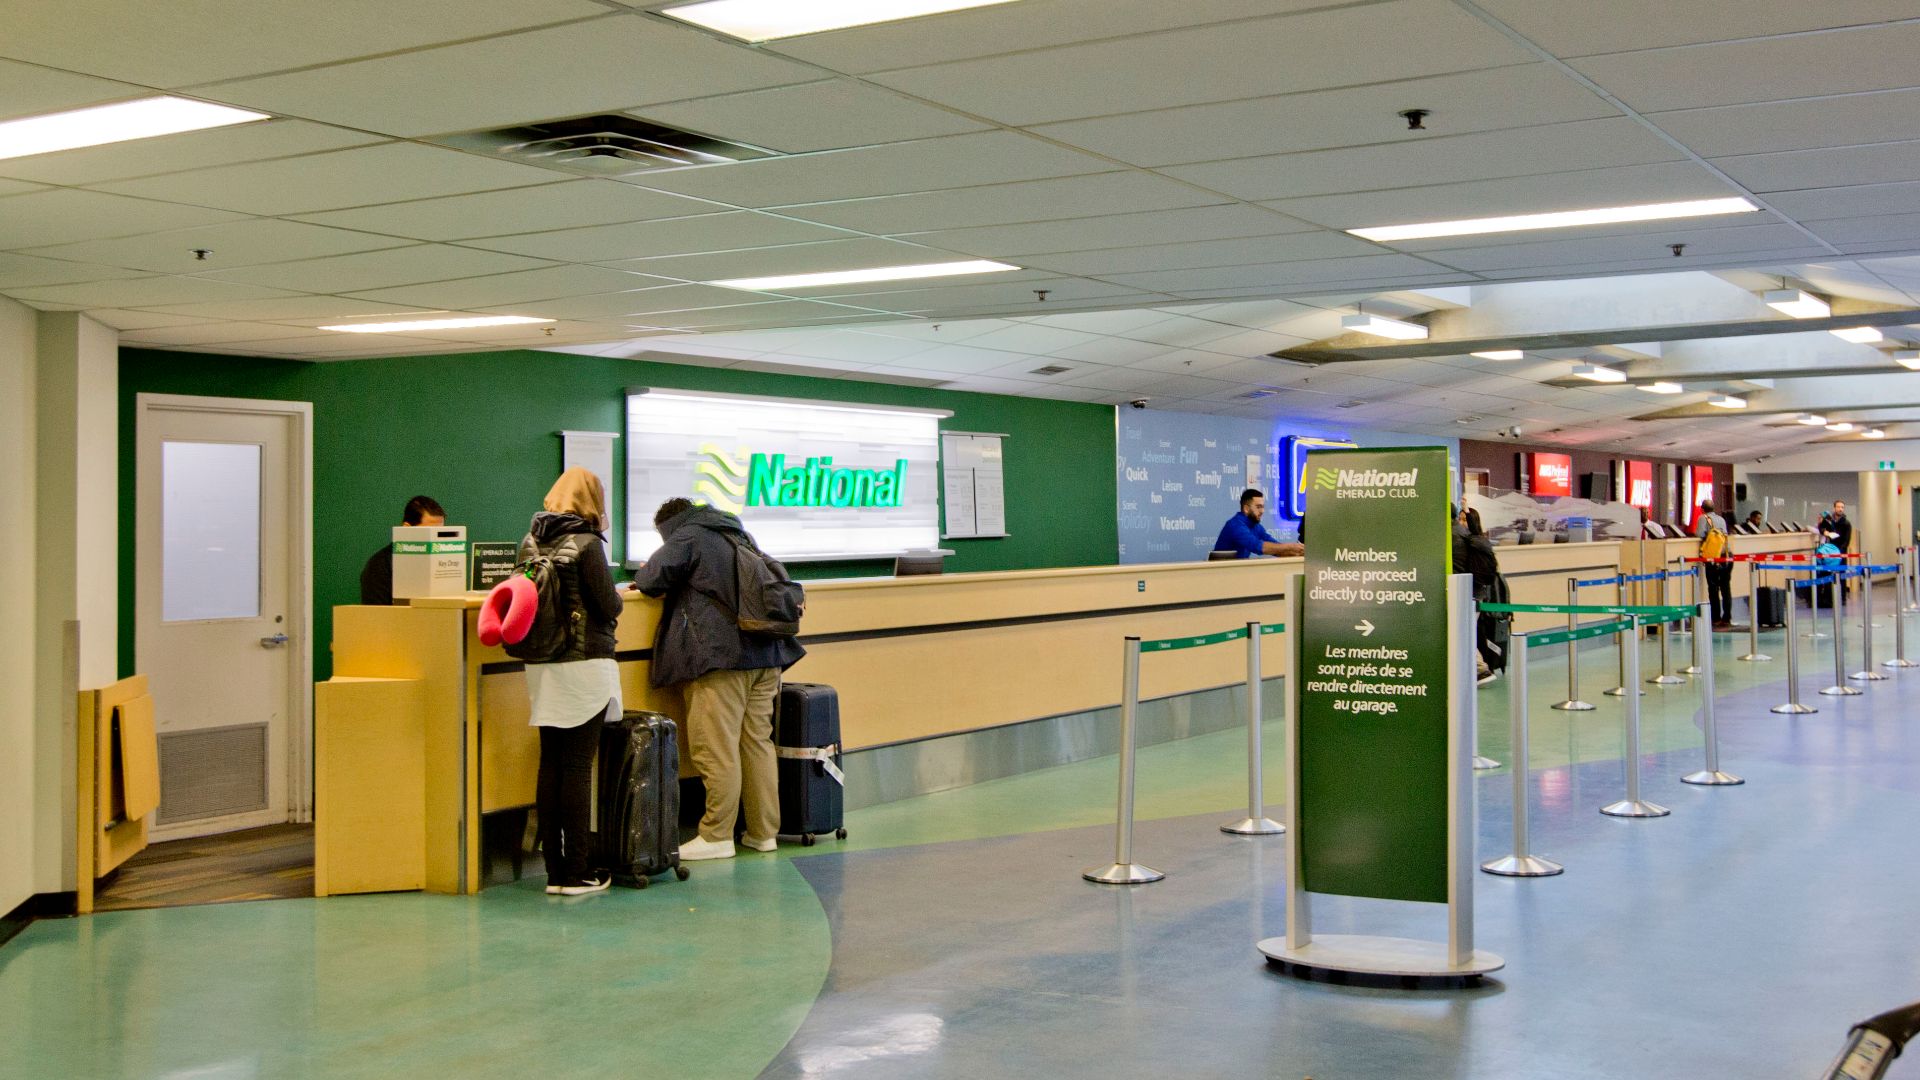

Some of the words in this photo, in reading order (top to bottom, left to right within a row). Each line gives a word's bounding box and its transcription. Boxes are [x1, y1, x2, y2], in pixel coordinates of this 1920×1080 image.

[1204, 438, 1217, 448] Travel
[1142, 450, 1176, 464] Adventure
[1180, 446, 1199, 464] Fun
[1126, 467, 1148, 482] Quick
[1222, 462, 1239, 475] Travel
[745, 452, 909, 507] National
[1196, 469, 1222, 489] Family
[1337, 468, 1418, 487] National
[1162, 479, 1183, 492] Leisure
[1188, 494, 1207, 507] Scenic
[1336, 489, 1386, 499] EMERALD
[1122, 500, 1138, 511] Scenic
[1160, 516, 1196, 531] Vacation
[439, 543, 466, 552] National
[1335, 548, 1398, 562] Members
[1318, 567, 1360, 584] please
[1362, 568, 1417, 584] proceed
[1309, 587, 1357, 604] directly
[1359, 588, 1374, 601] to
[1376, 591, 1426, 605] garage.
[1325, 645, 1346, 658] Les
[1348, 646, 1408, 660] membres
[1317, 664, 1345, 676] sont
[1346, 663, 1378, 679] priés
[1379, 663, 1397, 677] de
[1399, 666, 1414, 678] se
[1307, 679, 1348, 693] rendre
[1350, 680, 1428, 696] directement
[1333, 700, 1349, 710] au
[1351, 700, 1398, 715] garage.
